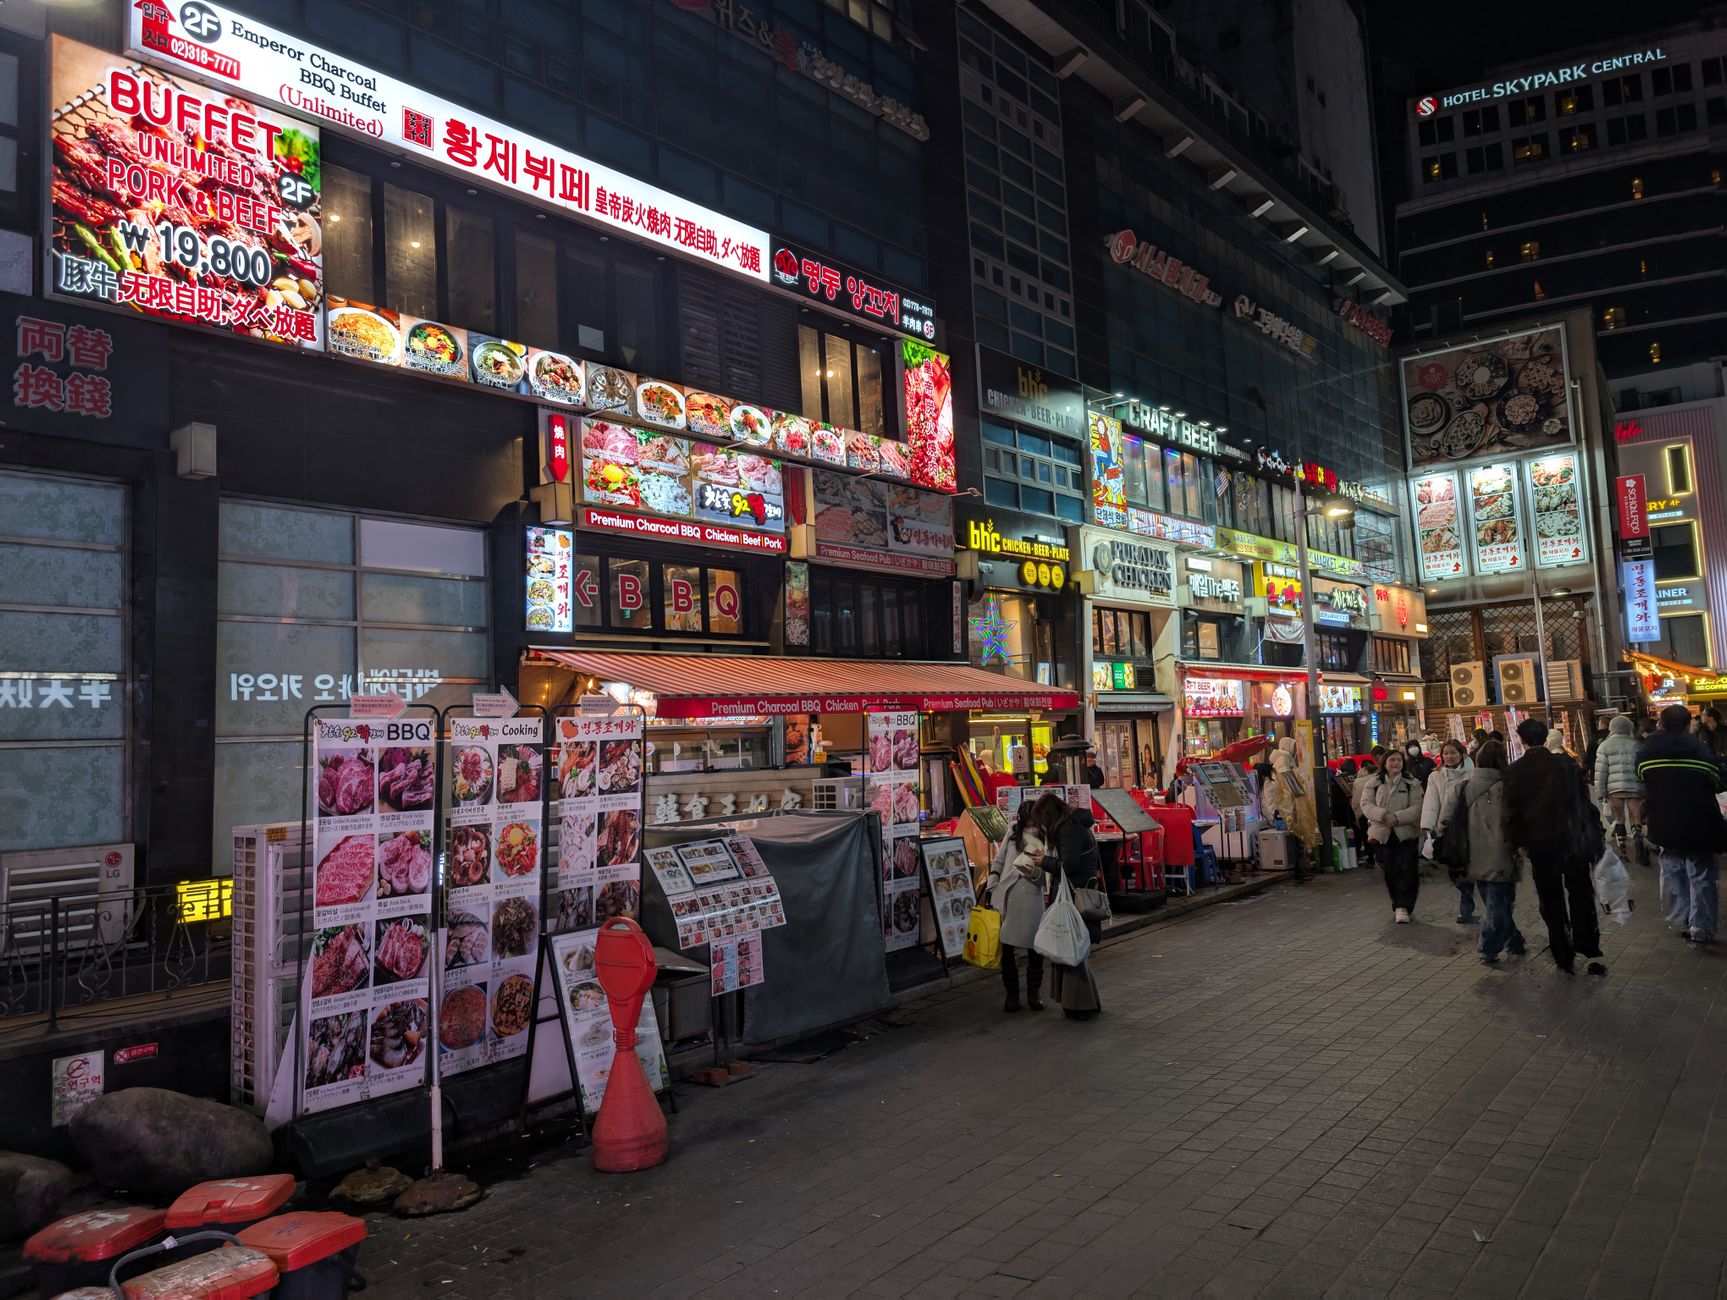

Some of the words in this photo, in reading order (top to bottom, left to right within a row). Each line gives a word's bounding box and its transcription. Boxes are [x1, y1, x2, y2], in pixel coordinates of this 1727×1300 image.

[142, 3, 169, 23] 입구
[184, 4, 219, 36] 2F
[171, 38, 238, 75] 02)318-7771
[231, 20, 305, 61] Emperor
[310, 54, 377, 91] Charcoal
[300, 68, 335, 94] BBQ
[340, 84, 386, 114] Buffet
[1444, 88, 1490, 108] HOTEL
[1493, 64, 1587, 98] SKYPARK
[1592, 49, 1666, 75] CENTRAL
[109, 70, 282, 161] BUFFET
[279, 83, 384, 138] (Unlimited)
[138, 132, 254, 188] UNLIMITED
[443, 118, 589, 211] 황제뷔페
[108, 157, 185, 210] PORK
[196, 192, 209, 217] &
[218, 191, 281, 235] BEEF
[280, 177, 312, 203] 2F
[161, 225, 271, 286] 19,800
[802, 258, 841, 300] 명동
[847, 276, 899, 325] 양꼬치
[16, 315, 113, 370] 両替
[1018, 366, 1048, 405] bhc
[1128, 401, 1178, 440] CRAFT
[1181, 422, 1219, 455] BEER
[590, 511, 634, 530] Premium
[636, 517, 679, 535] Charcoal
[680, 522, 701, 540] BBQ
[705, 528, 739, 544] Chicken
[742, 533, 761, 547] Beef
[764, 537, 782, 550] Pork
[970, 520, 1000, 552] bhc
[1002, 537, 1031, 555] CHICKEN
[1034, 543, 1049, 557] BEER
[1052, 547, 1070, 561] PLATE
[820, 545, 850, 560] Premium
[852, 551, 877, 564] Seafood
[879, 554, 892, 566] Pub
[1114, 541, 1171, 568] PURADAK
[1112, 564, 1172, 591] CHICKEN
[712, 701, 756, 715] Premium
[757, 699, 799, 714] Charcoal
[801, 700, 821, 713] BBQ
[825, 698, 859, 712] Chicken
[897, 715, 915, 726] BBQ
[924, 697, 953, 710] Premium
[954, 697, 980, 709] Seafood
[982, 697, 993, 708] Pub
[387, 723, 430, 741] BBQ
[502, 723, 538, 740] Cooking
[581, 719, 636, 736] 명동조개와
[106, 870, 120, 878] LG
